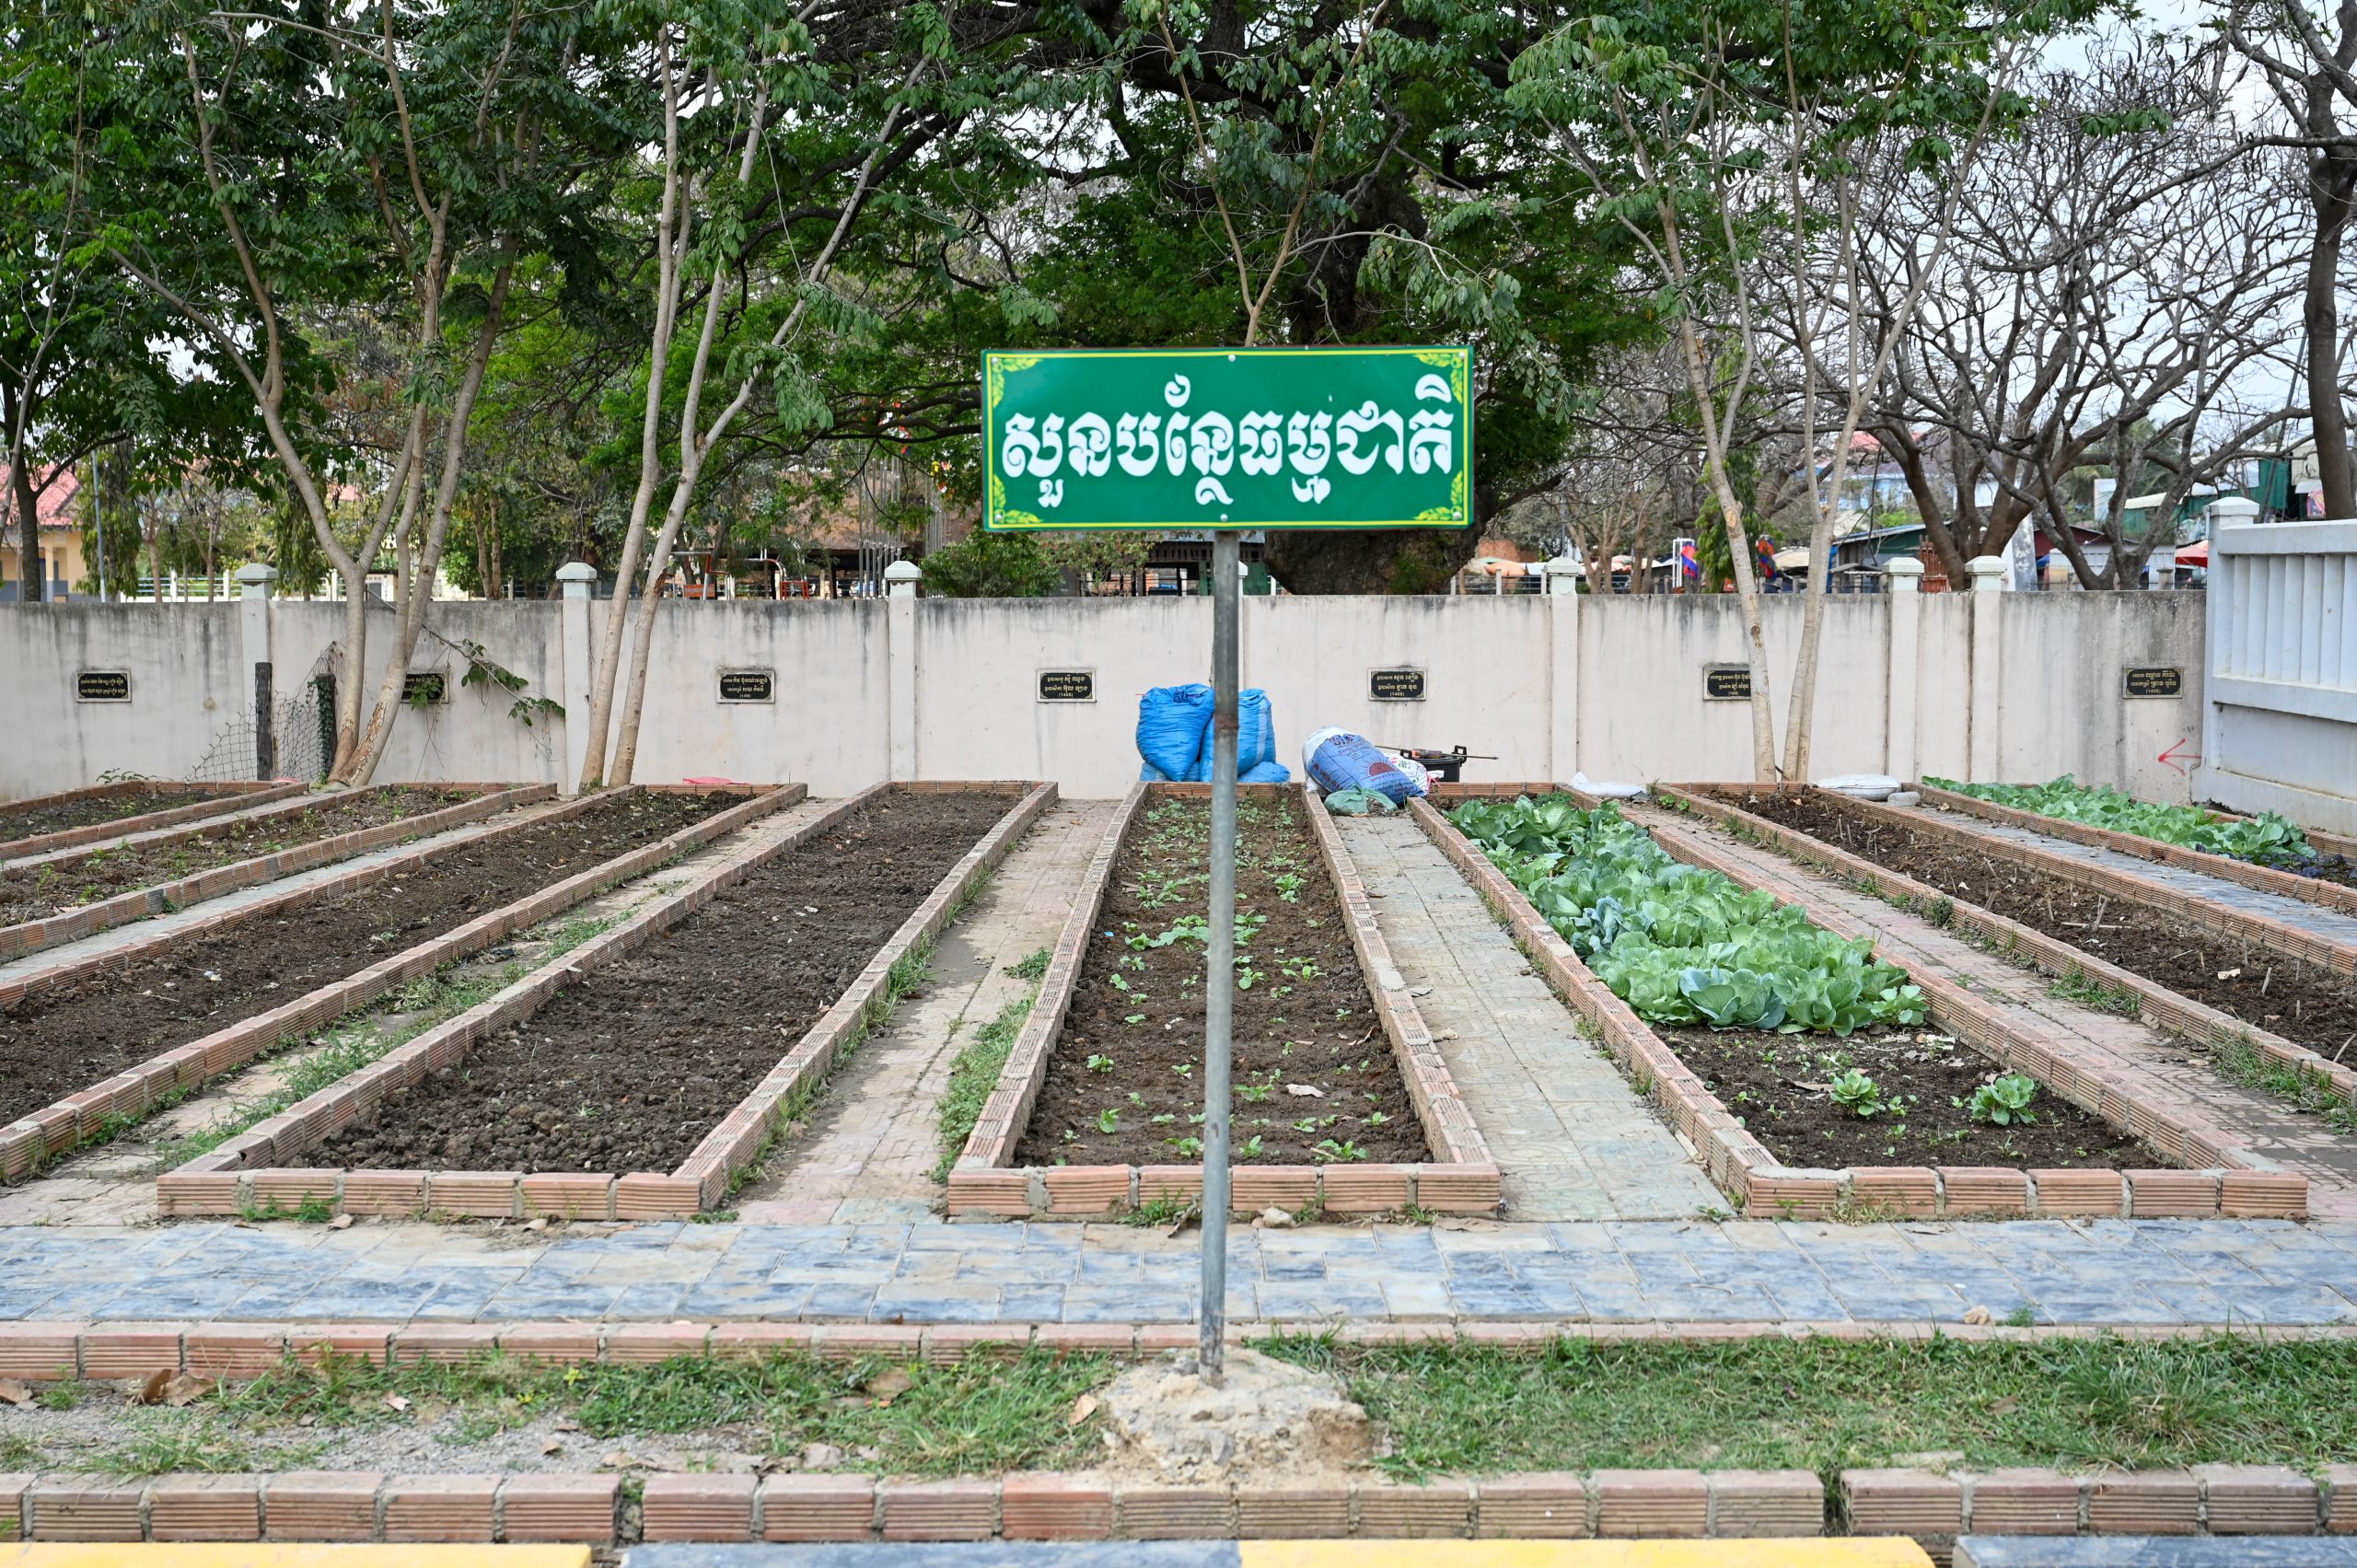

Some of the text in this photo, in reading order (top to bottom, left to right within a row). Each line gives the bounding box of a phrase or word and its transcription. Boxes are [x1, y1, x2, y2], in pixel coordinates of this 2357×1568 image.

[1001, 372, 1455, 507] សួនបន្លែធម្មជាតិ
